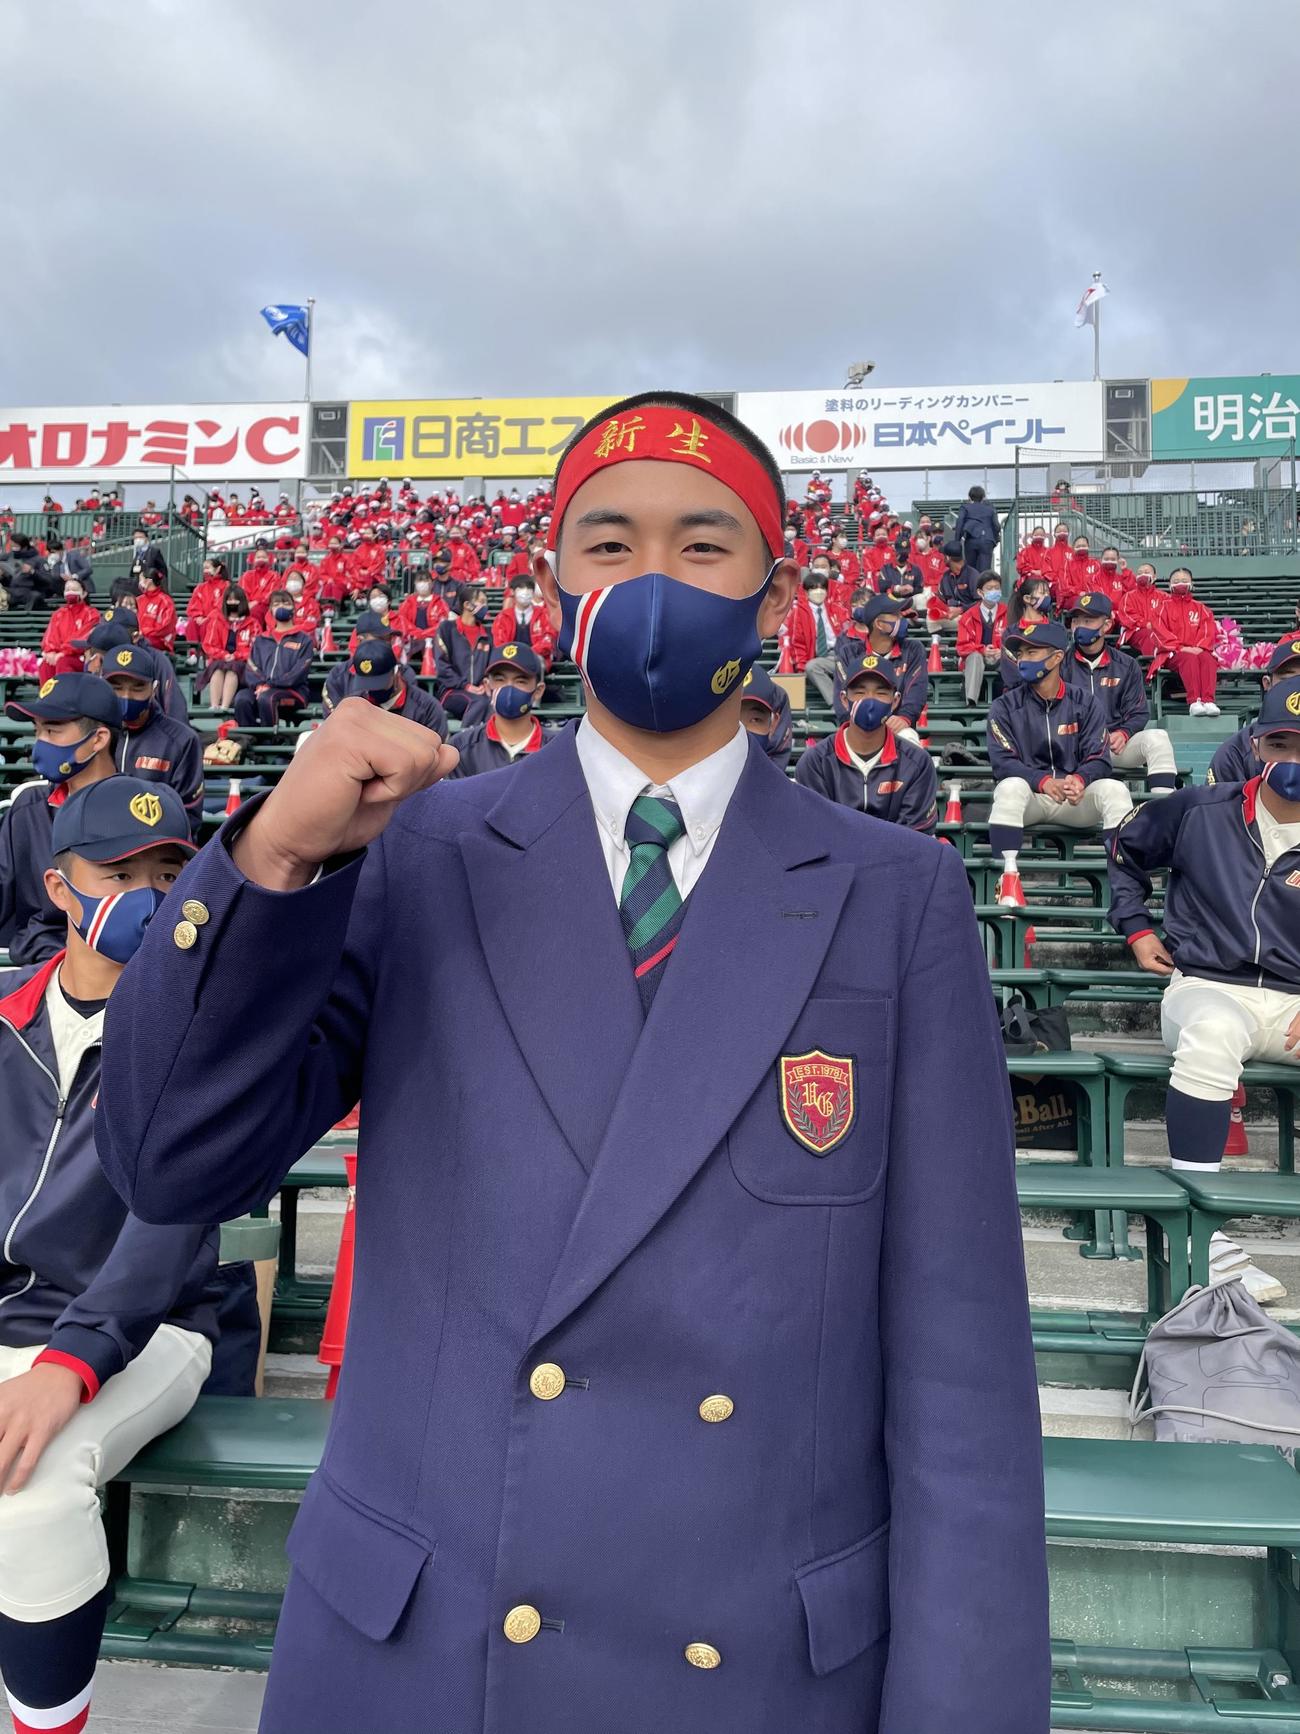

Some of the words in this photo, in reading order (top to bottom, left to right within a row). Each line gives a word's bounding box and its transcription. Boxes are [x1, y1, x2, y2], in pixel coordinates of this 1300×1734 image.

[824, 394, 1030, 413] 塗料のリーディングカンパニー
[1193, 391, 1300, 442] 明治
[593, 415, 712, 464] 新生
[873, 418, 1066, 448] 日本ペイント
[790, 455, 818, 465] Basic
[827, 454, 854, 464] New
